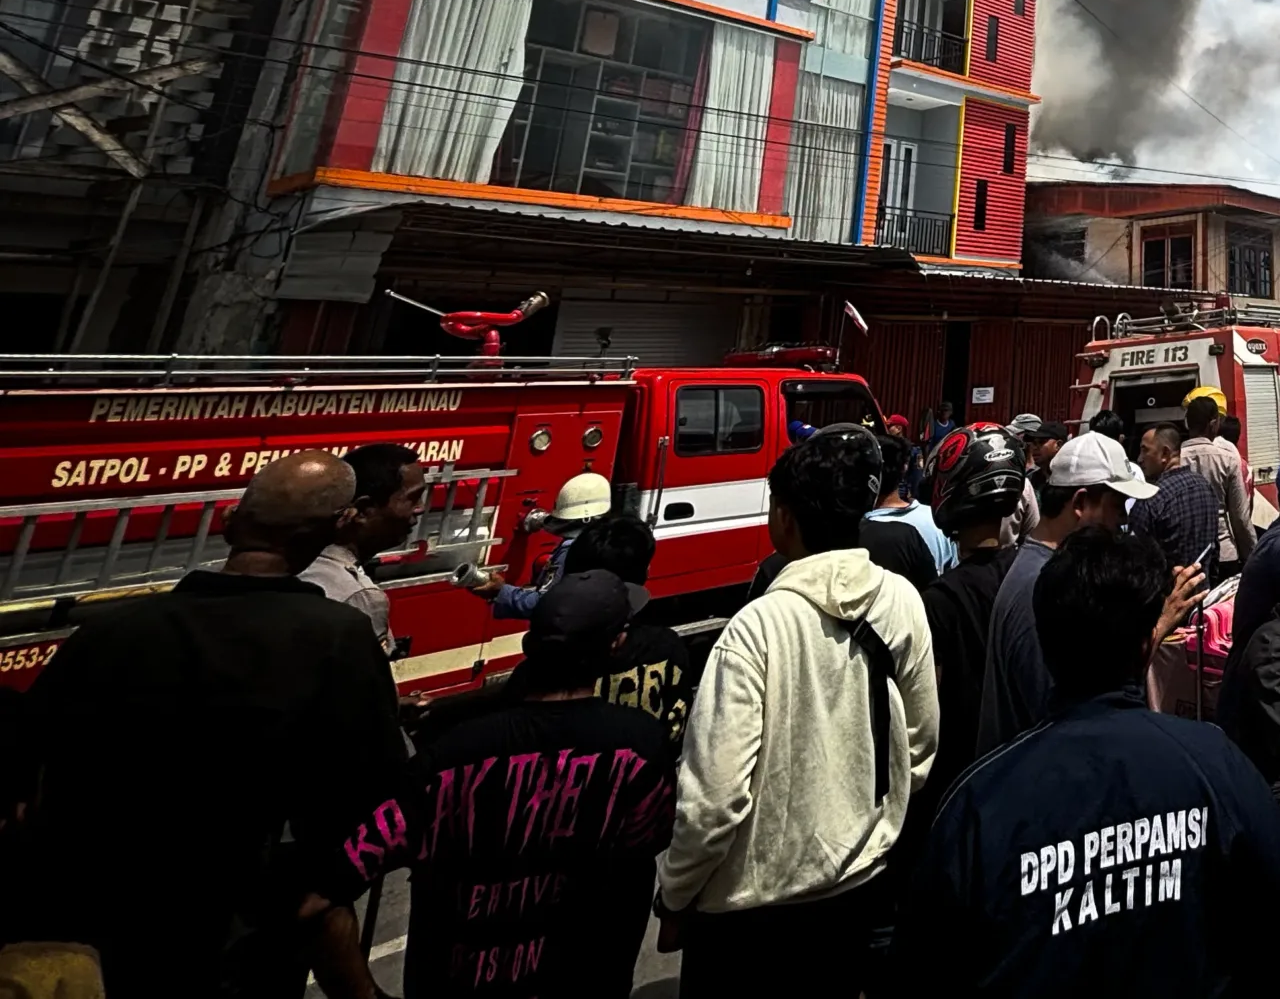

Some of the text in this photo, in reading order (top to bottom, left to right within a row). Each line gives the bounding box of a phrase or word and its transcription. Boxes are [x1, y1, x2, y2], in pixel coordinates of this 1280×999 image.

[1120, 345, 1189, 368] FIRE 113
[88, 389, 463, 423] PEMERINTAH KABUPATEN MALINAU
[51, 456, 151, 488] SATPOL
[172, 454, 208, 480] PP
[214, 452, 233, 477] &
[1020, 806, 1209, 896] DPD PERPAMSI
[1051, 858, 1182, 936] KALTIM
